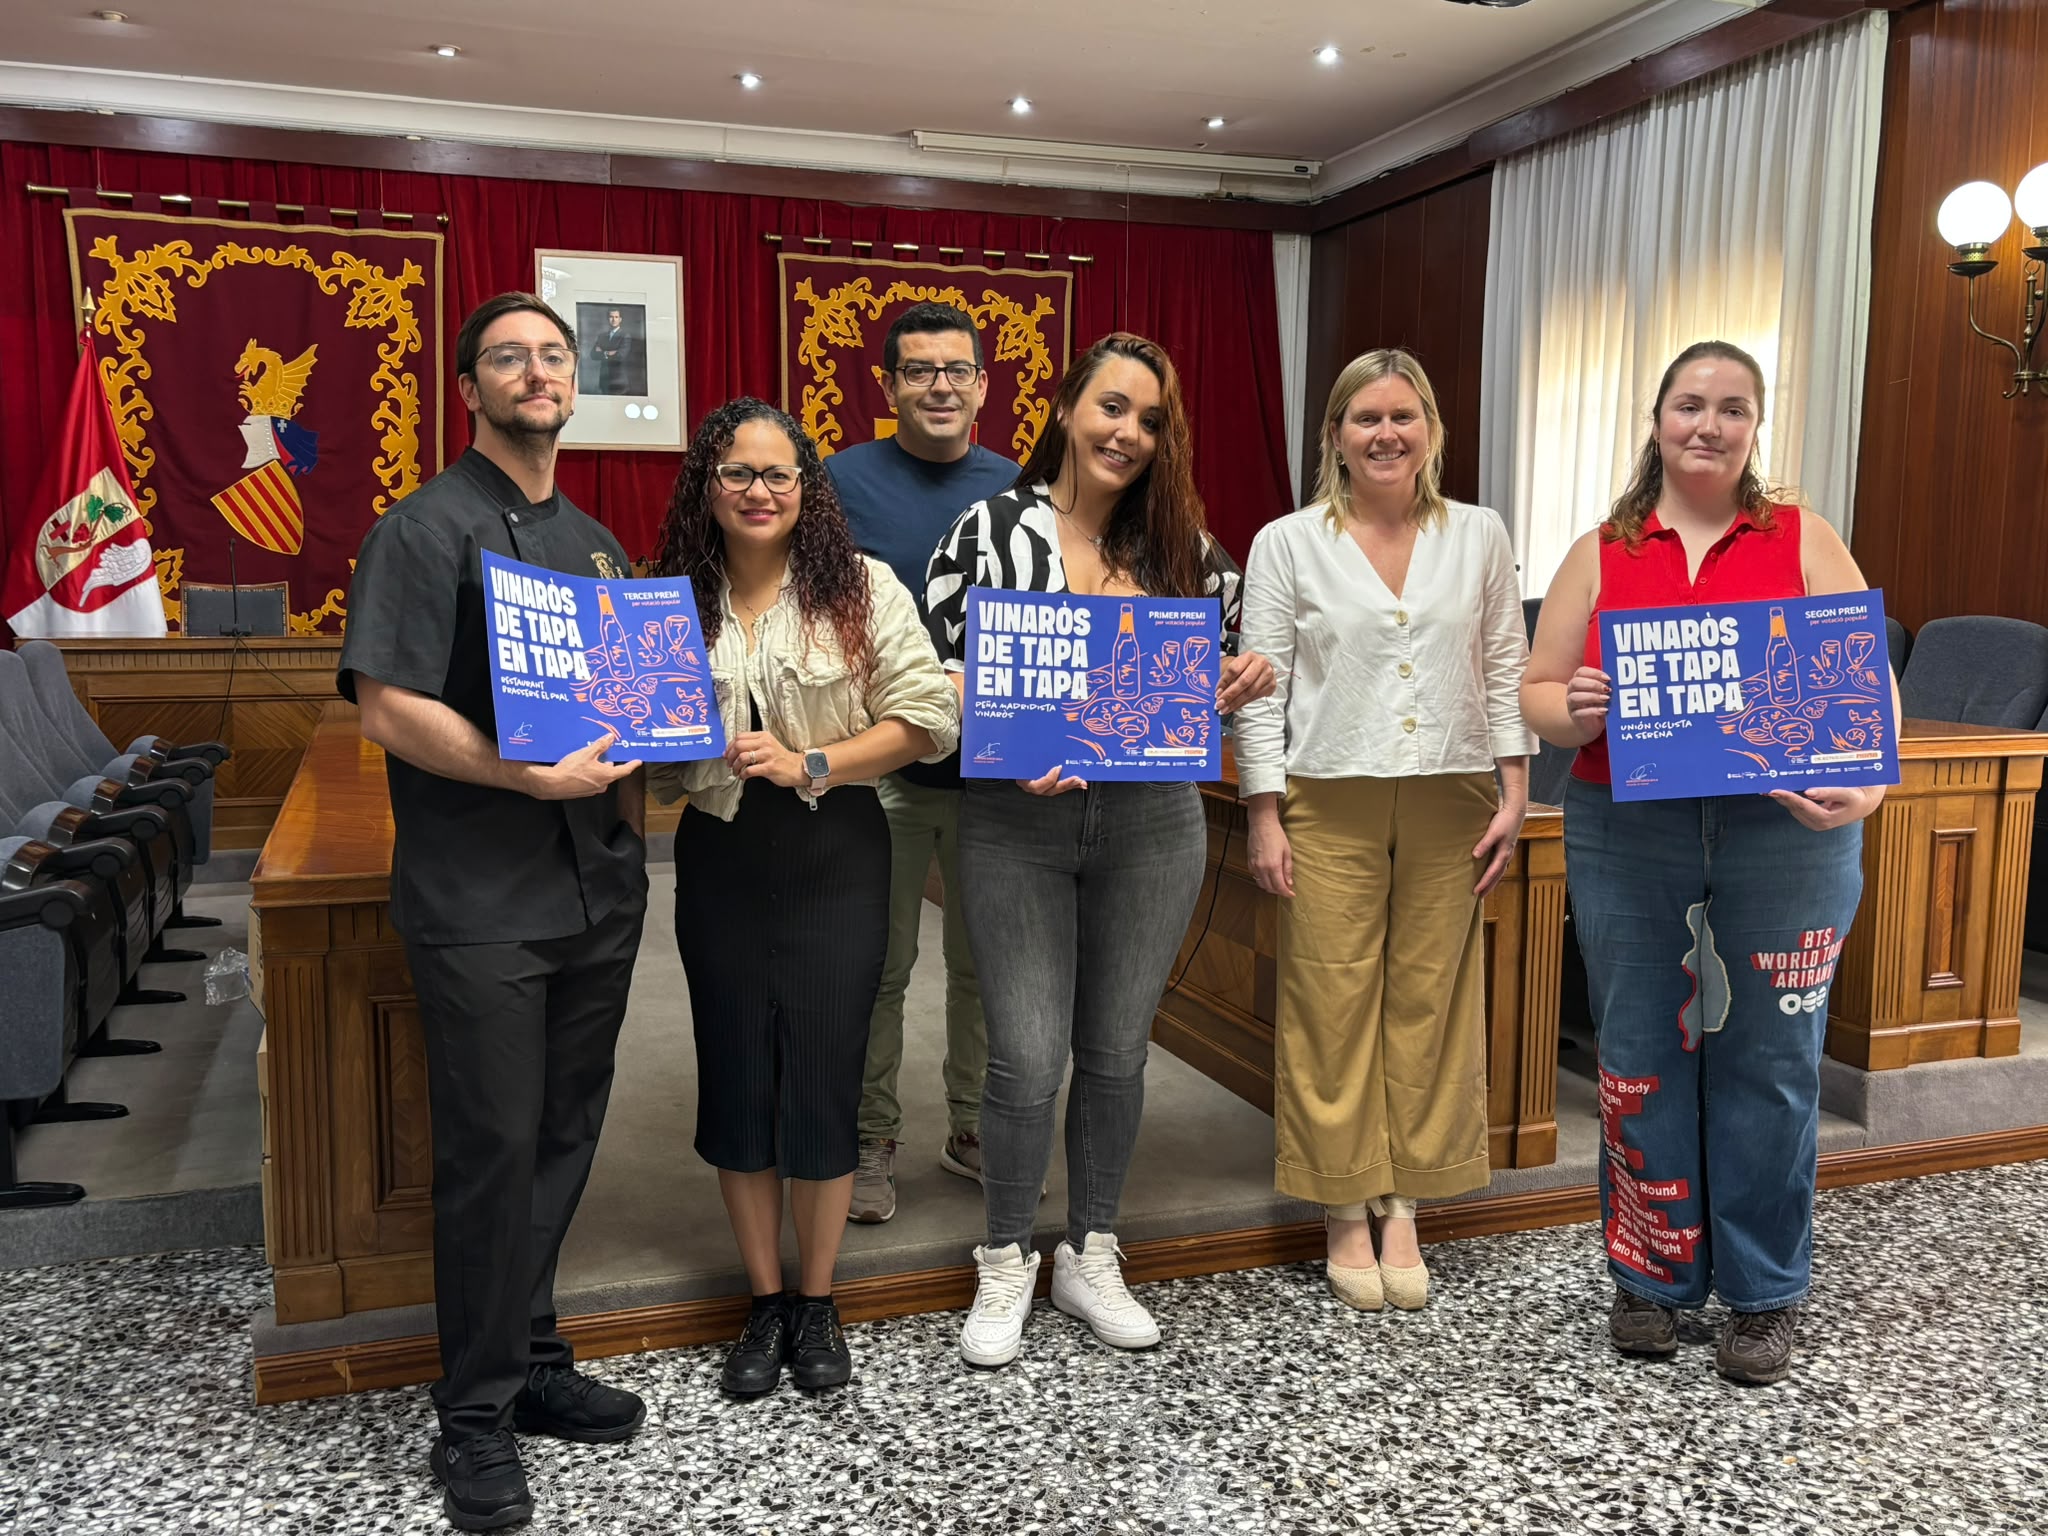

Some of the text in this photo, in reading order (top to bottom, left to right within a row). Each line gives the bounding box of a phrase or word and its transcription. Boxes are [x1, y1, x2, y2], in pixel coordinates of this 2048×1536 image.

[490, 566, 577, 616] VINARÒS
[623, 590, 680, 601] TERCER PREMI
[978, 600, 1091, 636] VINARÒS
[1148, 610, 1206, 620] PRIMER PREMI
[1804, 605, 1868, 620] SEGON PREMI
[494, 601, 584, 649] DE TAPA
[1613, 611, 1739, 653] VINARÒS
[497, 637, 592, 681] EN TAPA
[977, 633, 1089, 669] DE TAPA
[1616, 649, 1741, 686] DE TAPA
[501, 676, 545, 691] RESTAURANT
[502, 685, 541, 699] BRASSERIE
[541, 690, 549, 700] EL
[976, 666, 1089, 701] EN TAPA
[975, 700, 1056, 712] PEÑA MADRIDISTA
[1618, 681, 1744, 719] EN TAPA
[975, 709, 1015, 718] VINARÒS
[1620, 721, 1651, 731] UNIÓN
[1621, 730, 1673, 741] LA SERENA
[1804, 927, 1833, 949] BTS
[1757, 950, 1819, 970] WORLD
[1617, 1080, 1650, 1095] Body
[1640, 1182, 1678, 1197] Round
[1617, 1225, 1643, 1249] Please
[1649, 1224, 1679, 1241] know
[1682, 1224, 1702, 1240] 'bou
[1651, 1237, 1682, 1255] Night
[1611, 1239, 1664, 1276] Into the Sun
